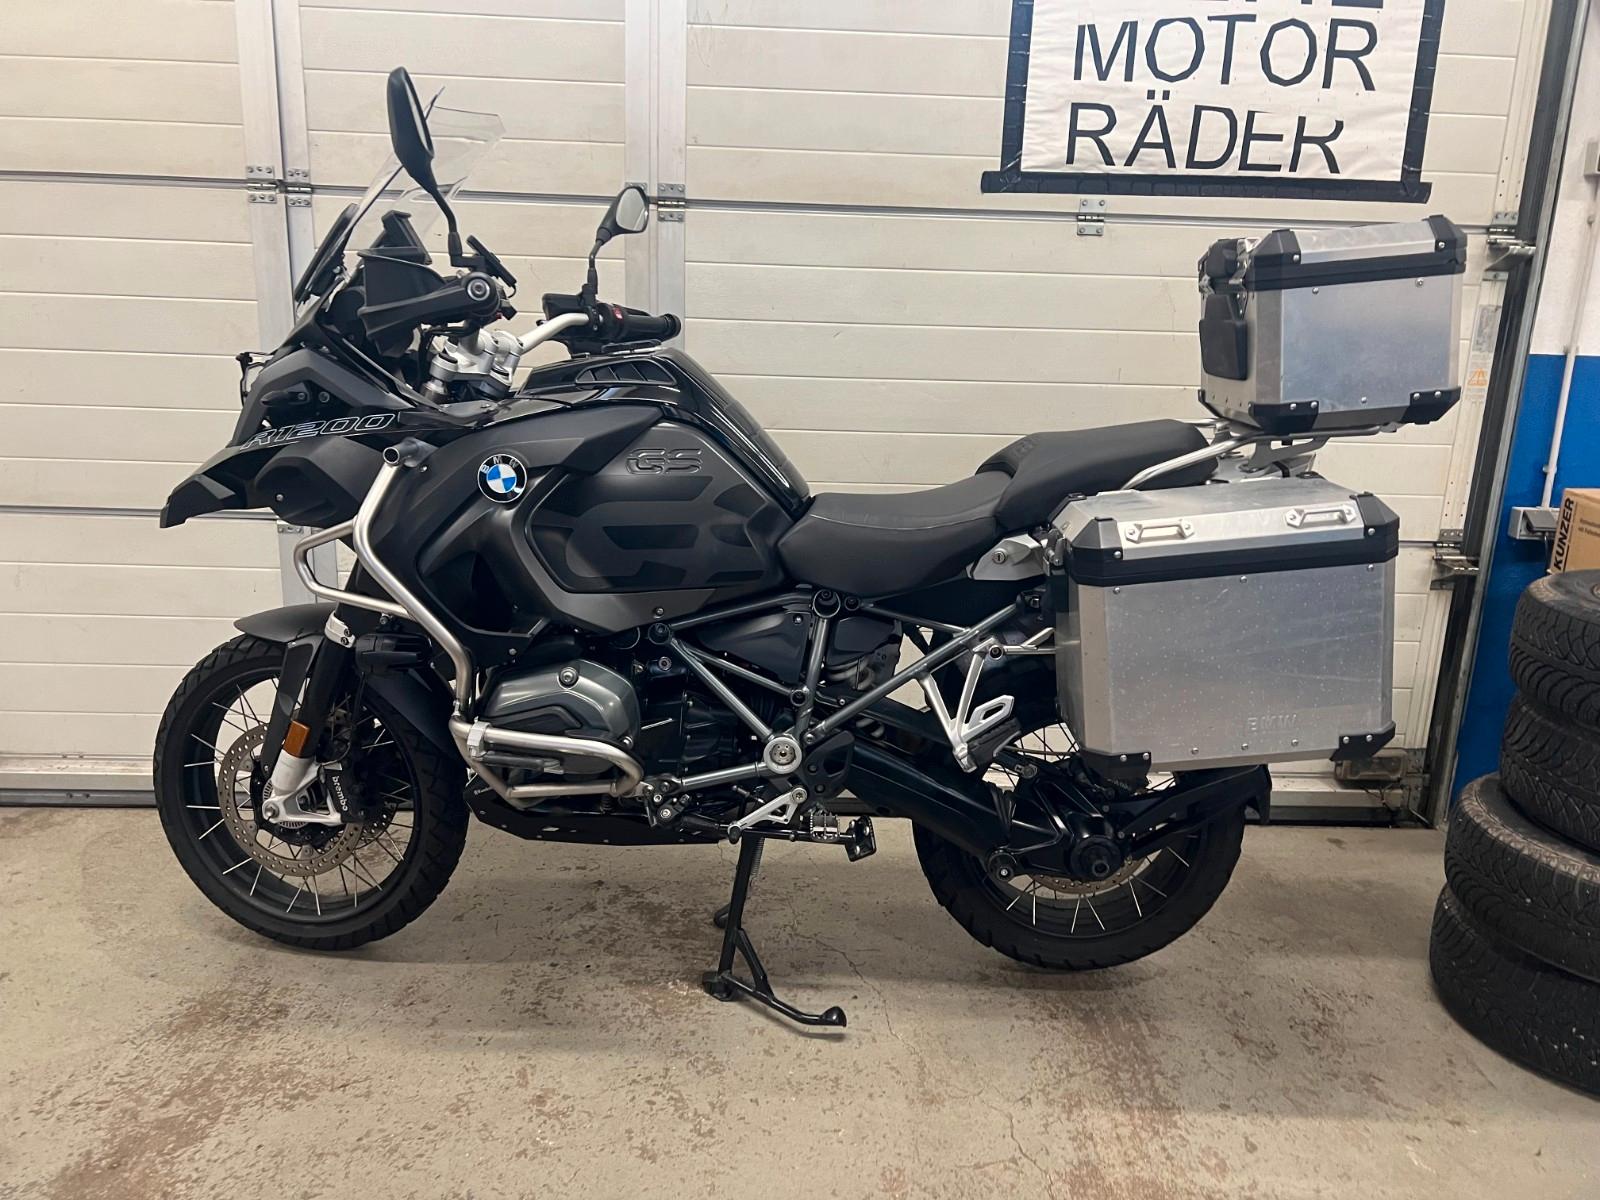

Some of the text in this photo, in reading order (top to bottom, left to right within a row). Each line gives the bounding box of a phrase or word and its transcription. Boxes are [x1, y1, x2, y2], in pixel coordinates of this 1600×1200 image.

[1073, 14, 1378, 91] MOTOR
[1066, 89, 1344, 174] RÄDER
[239, 413, 396, 451] R1200
[480, 455, 520, 474] BMW
[626, 448, 703, 475] GS
[1553, 497, 1574, 570] KUNZER
[332, 775, 348, 811] brembo
